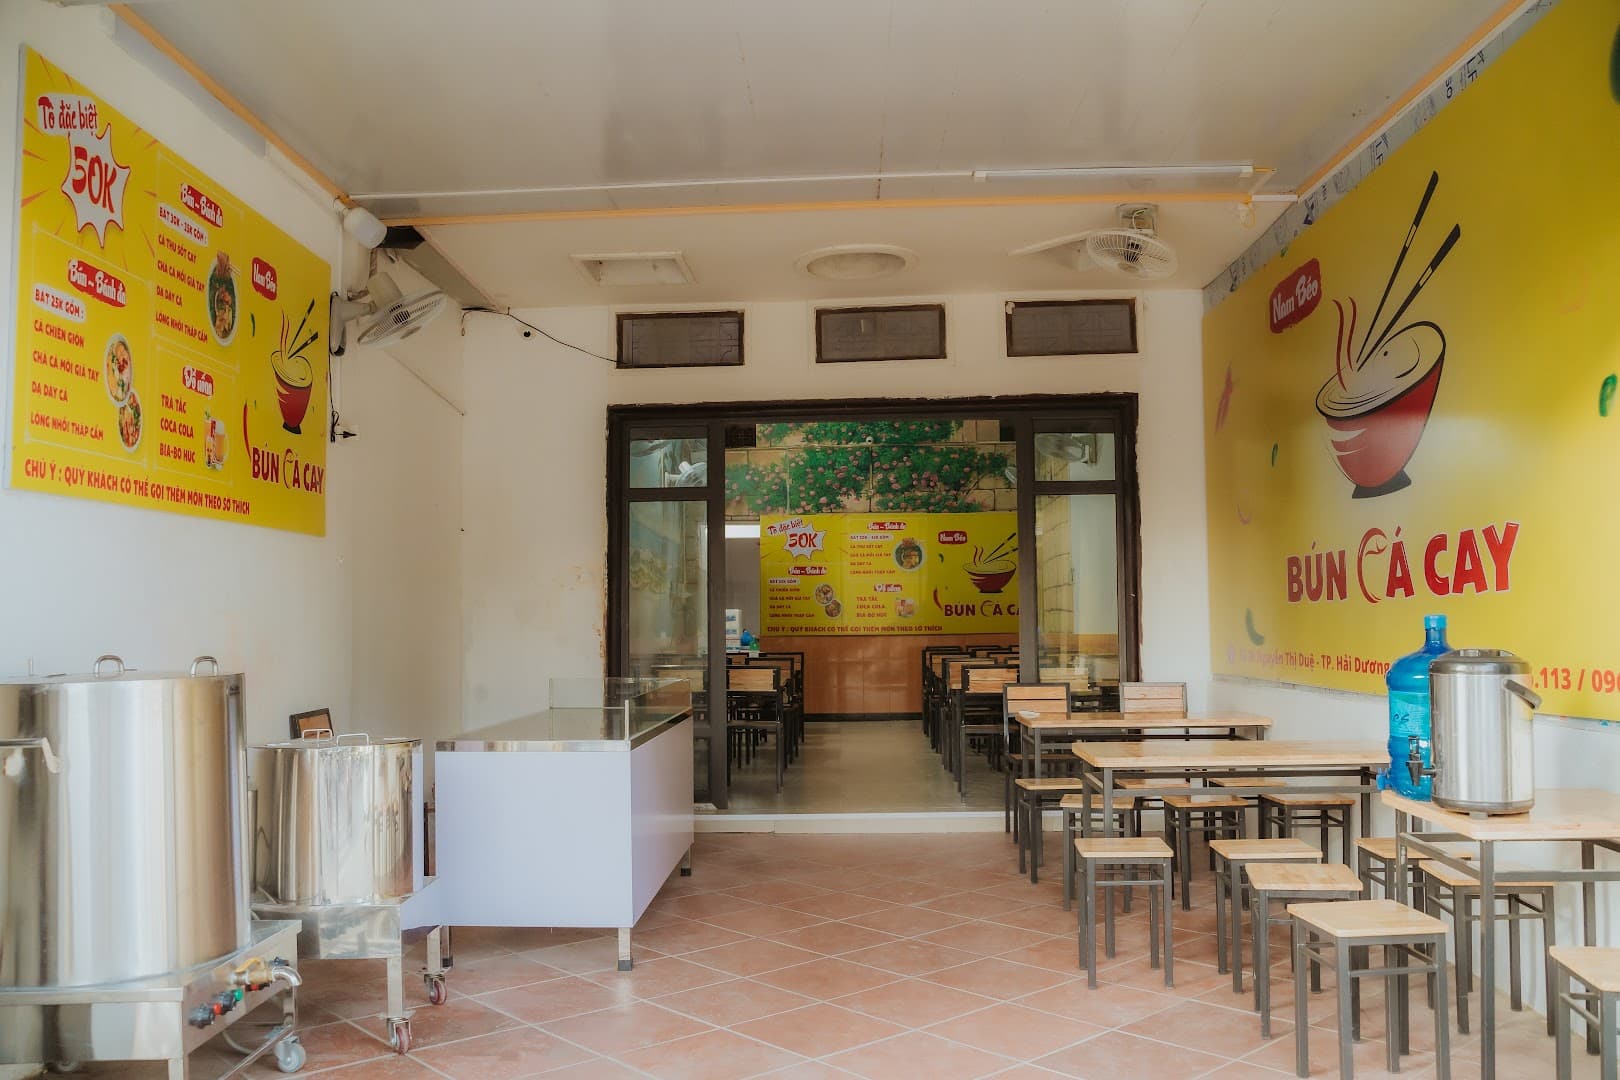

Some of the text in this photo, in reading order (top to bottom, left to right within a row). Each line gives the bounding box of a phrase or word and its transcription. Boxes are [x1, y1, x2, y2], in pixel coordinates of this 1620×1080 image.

[38, 96, 54, 129] Tô
[78, 100, 98, 136] biệt
[72, 146, 116, 213] 50K
[51, 295, 63, 310] 25K
[1273, 274, 1319, 324] Nam Béo
[160, 417, 194, 439] COCA COLA
[25, 457, 47, 479] CHÚ
[64, 464, 85, 487] QUÝ
[87, 469, 118, 491] KHÁCH
[120, 474, 131, 494] CÓ
[166, 485, 186, 504] THÊM
[204, 493, 222, 510] THEO
[252, 442, 280, 483] BÚN
[303, 462, 324, 494] CAY
[788, 532, 818, 548] 50K
[1287, 521, 1520, 604] BÚN CÁ CAY
[1285, 650, 1297, 671] Thị
[1299, 652, 1315, 672] Duệ
[1321, 654, 1335, 670] TP.
[1336, 653, 1352, 672] Hải
[1591, 669, 1620, 693] 09
